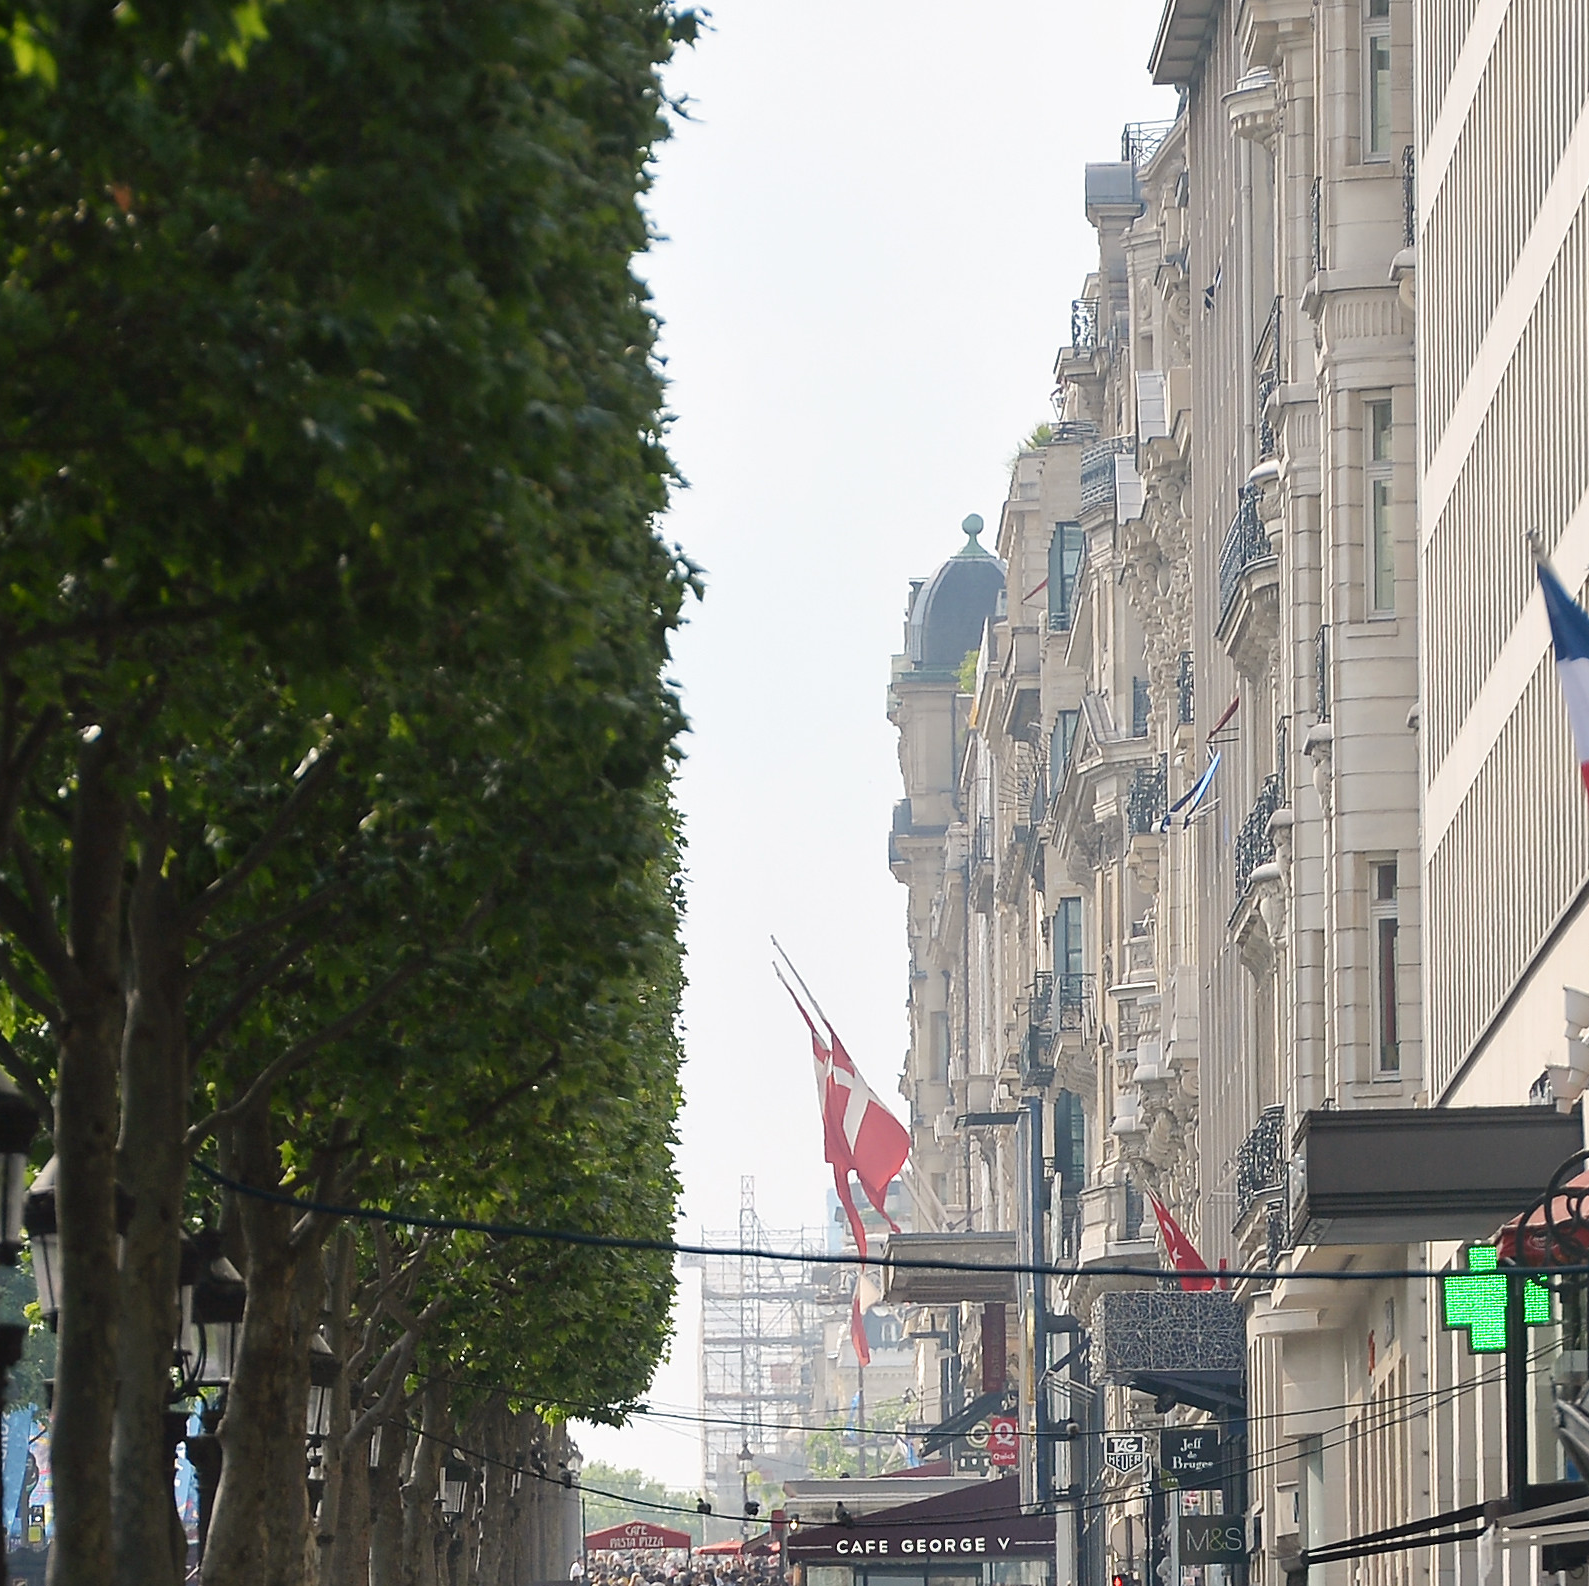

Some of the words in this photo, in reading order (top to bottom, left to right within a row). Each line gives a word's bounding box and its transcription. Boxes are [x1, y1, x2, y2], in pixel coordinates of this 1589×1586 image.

[994, 1422, 1015, 1447] Q
[1111, 1438, 1138, 1453] TAG
[1180, 1437, 1203, 1452] Jeff
[993, 1452, 1016, 1461] Quick
[1108, 1453, 1142, 1471] HEUER
[1187, 1450, 1198, 1459] de
[1172, 1455, 1214, 1473] Bruges
[625, 1525, 648, 1536] CAFE
[609, 1537, 636, 1548] PASTA
[638, 1536, 664, 1547] PIZZA
[836, 1539, 889, 1554] CAFE
[901, 1537, 986, 1553] GEORGE
[997, 1536, 1011, 1550] V
[1186, 1527, 1242, 1551] M&S
